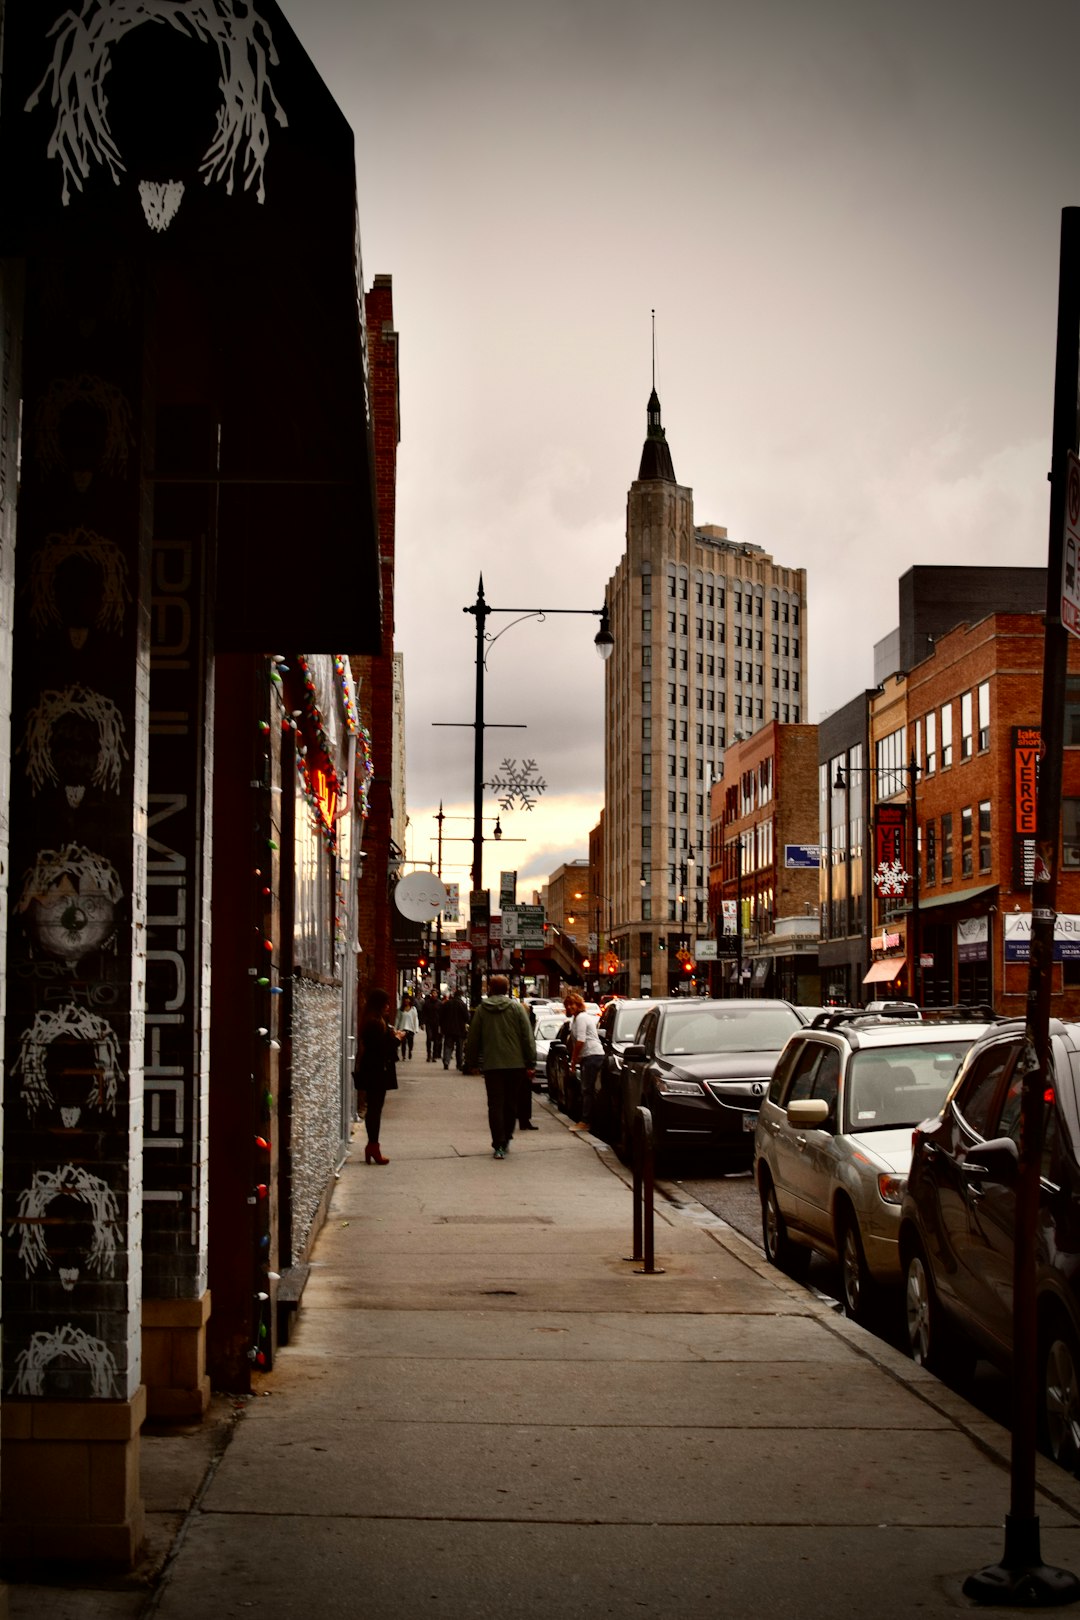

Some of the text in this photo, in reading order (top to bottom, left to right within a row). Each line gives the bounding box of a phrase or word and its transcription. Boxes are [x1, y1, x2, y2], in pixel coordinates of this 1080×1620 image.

[1017, 738, 1041, 746] shor
[1019, 751, 1033, 830] VERGE
[879, 827, 893, 863] VER
[1016, 920, 1080, 932] AVABL
[143, 793, 190, 1202] MITCHELL
